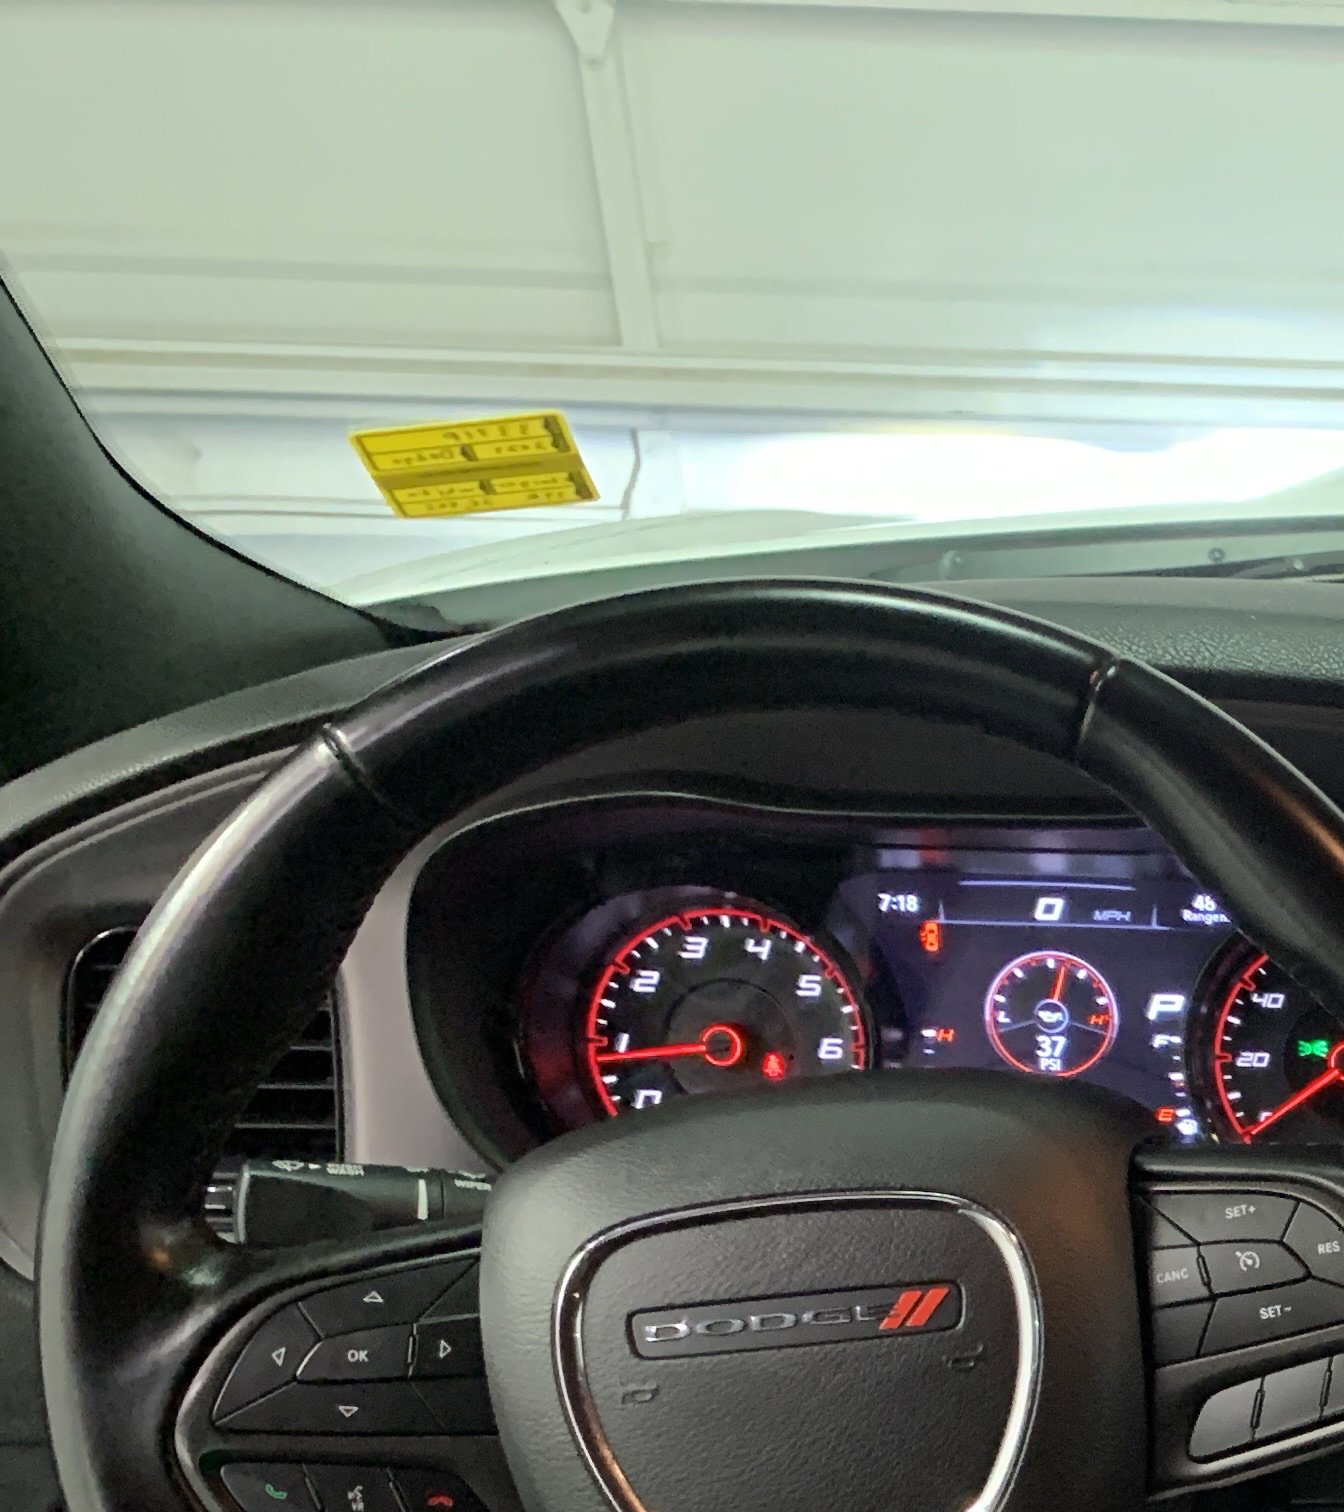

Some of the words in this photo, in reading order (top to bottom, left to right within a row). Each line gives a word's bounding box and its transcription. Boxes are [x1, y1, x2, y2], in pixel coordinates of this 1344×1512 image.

[877, 892, 921, 913] 7:18
[1034, 896, 1065, 922] 0
[1093, 910, 1132, 922] MPH
[677, 935, 709, 960] 3
[744, 937, 771, 961] 4
[630, 969, 660, 993] 2
[796, 974, 821, 997] 5
[1147, 993, 1186, 1021] P
[1252, 993, 1285, 1009] 40
[818, 1037, 843, 1060] 6
[1036, 1035, 1067, 1057] 37
[1039, 1058, 1062, 1071] PSI
[1236, 1052, 1270, 1068] 20
[1316, 1240, 1341, 1255] RES
[1156, 1267, 1190, 1284] CANC
[644, 1302, 902, 1343] DODGE
[347, 1349, 369, 1363] OK
